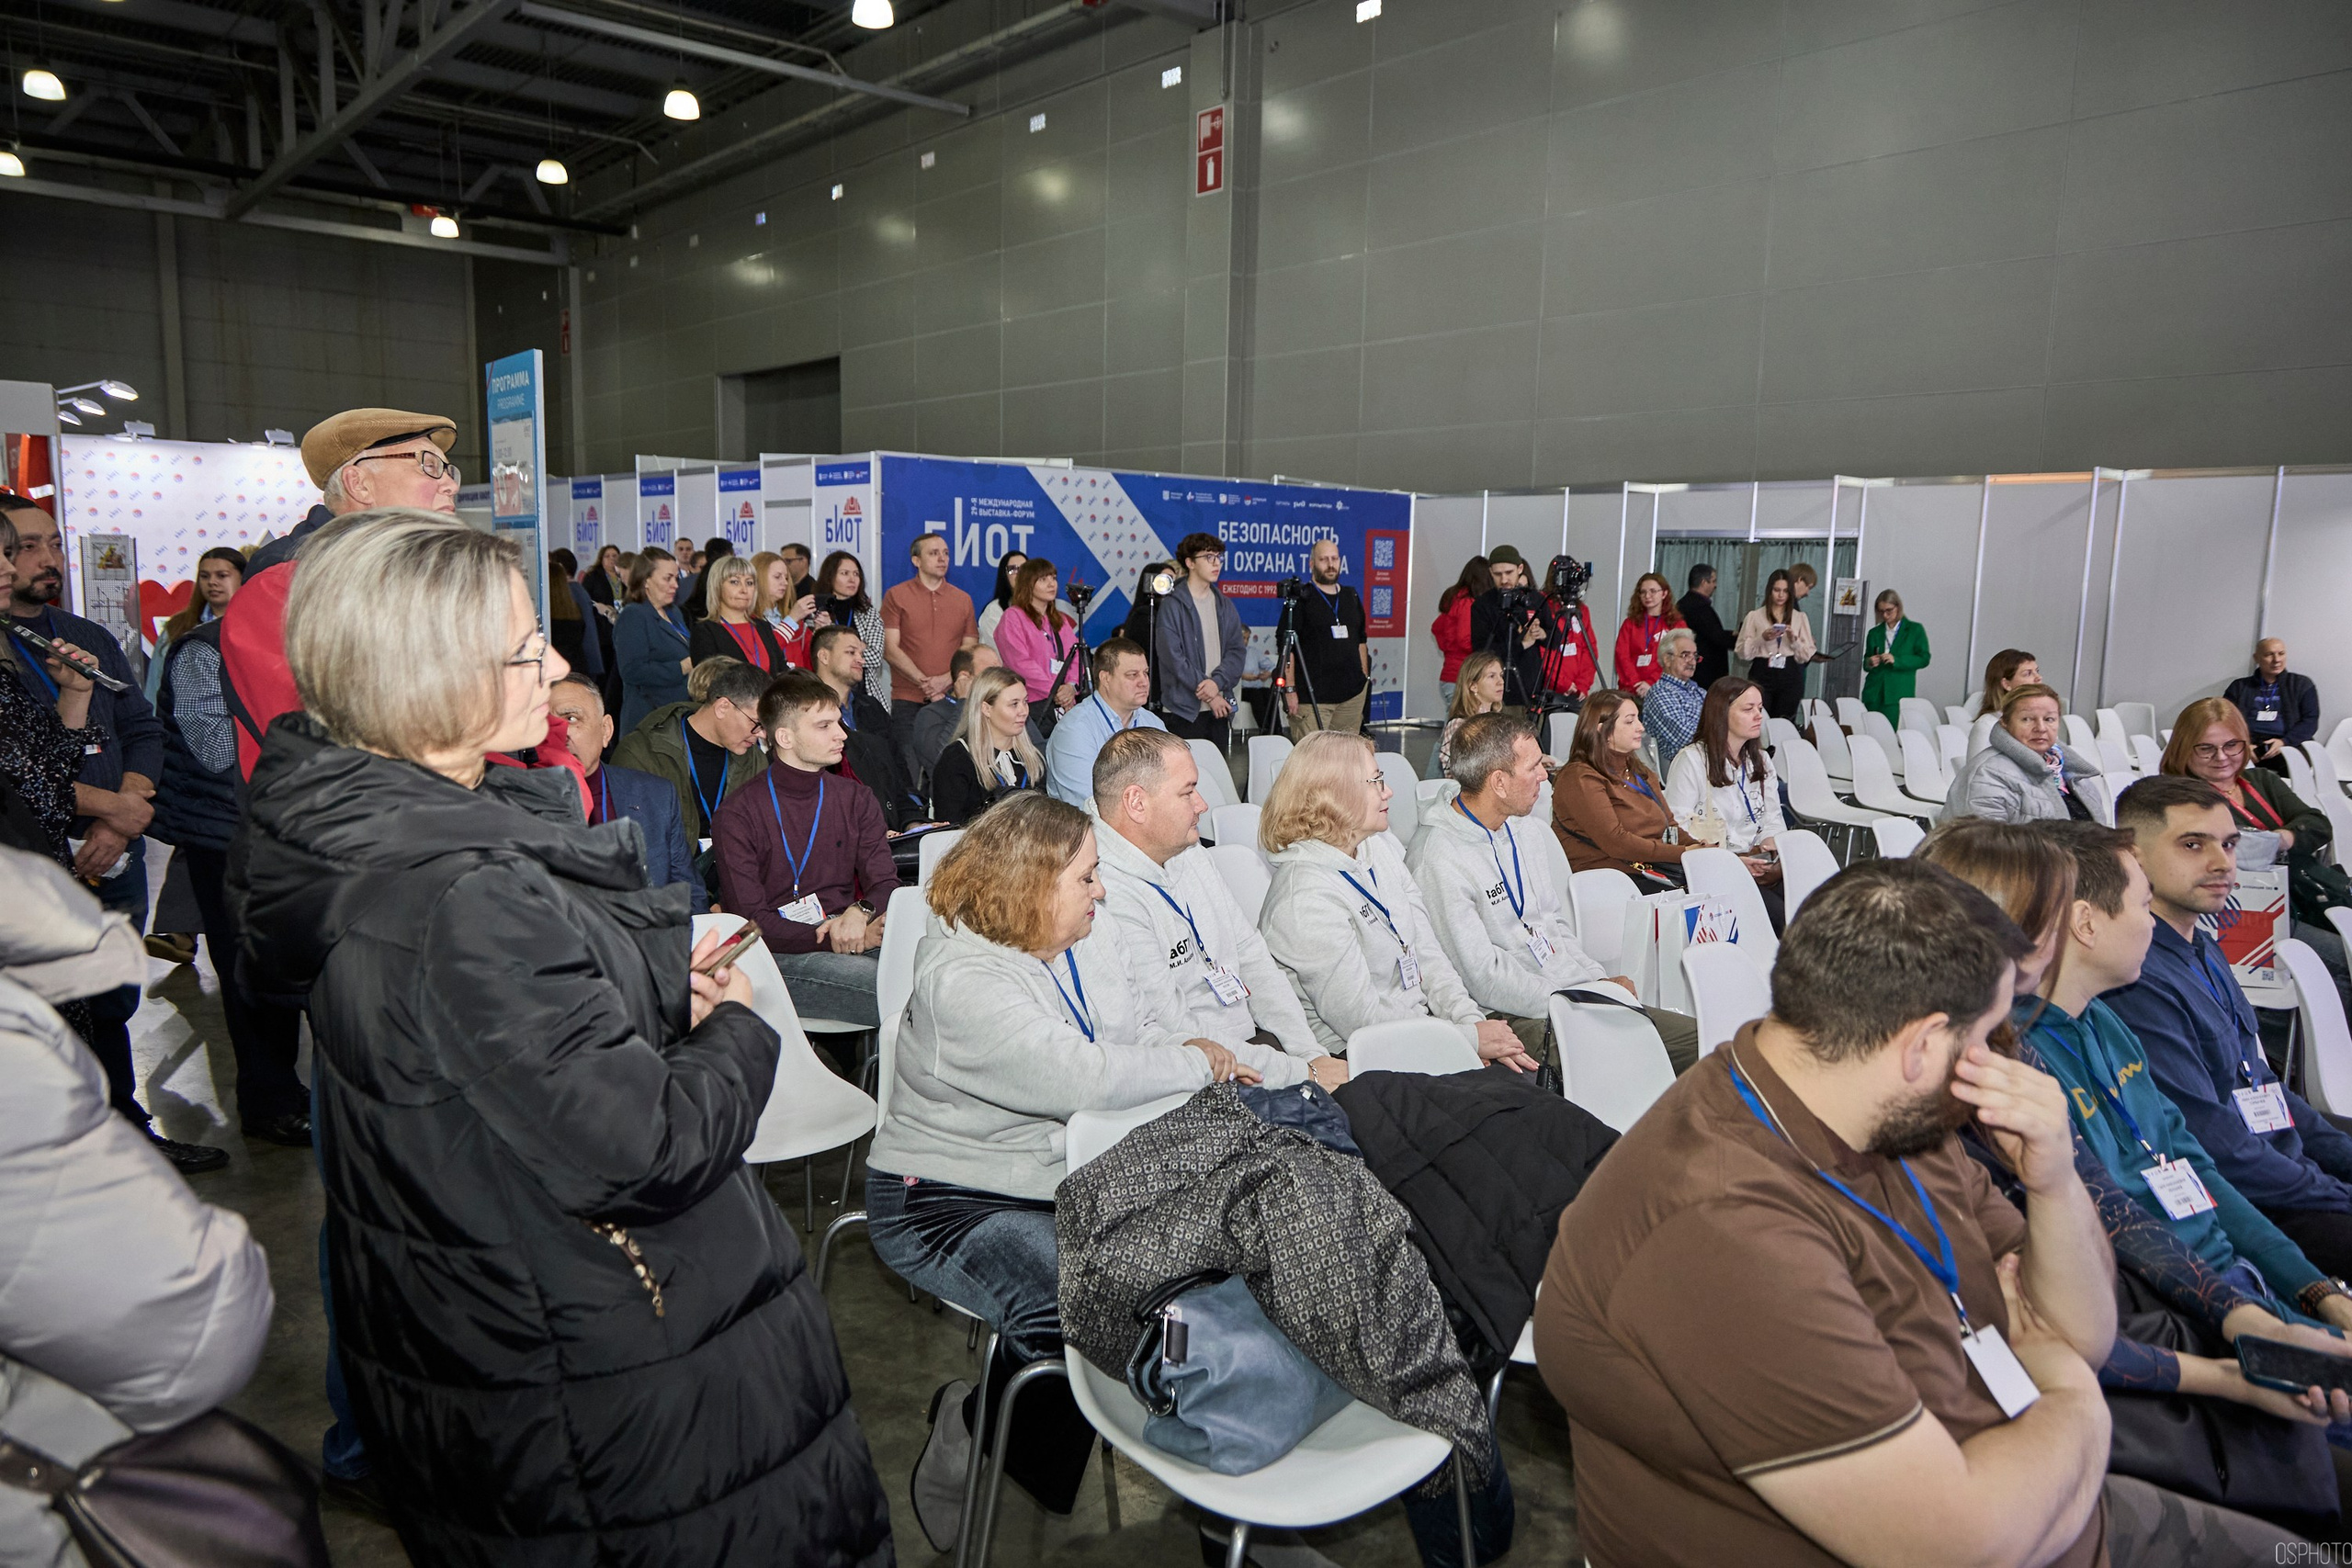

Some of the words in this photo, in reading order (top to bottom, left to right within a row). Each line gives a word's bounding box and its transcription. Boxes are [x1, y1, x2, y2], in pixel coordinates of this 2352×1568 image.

[492, 370, 530, 394] ПРОГРАММА
[978, 498, 1033, 508] МЕЖДУНАРОДНАЯ
[978, 508, 1035, 518] ВЫСТАВКА-ФОРУМ
[576, 512, 599, 549] БИОТ
[646, 510, 671, 551] БИОТ
[726, 508, 754, 552] БИОТ
[825, 504, 862, 553] БИОТ
[924, 497, 1035, 568] ИОТ
[1218, 521, 1340, 547] БЕЗОПАСНОСТЬ
[1234, 551, 1295, 573] ОХРАНА
[1222, 584, 1257, 594] ЕЖЕГОДНО
[1263, 585, 1277, 595] 1992
